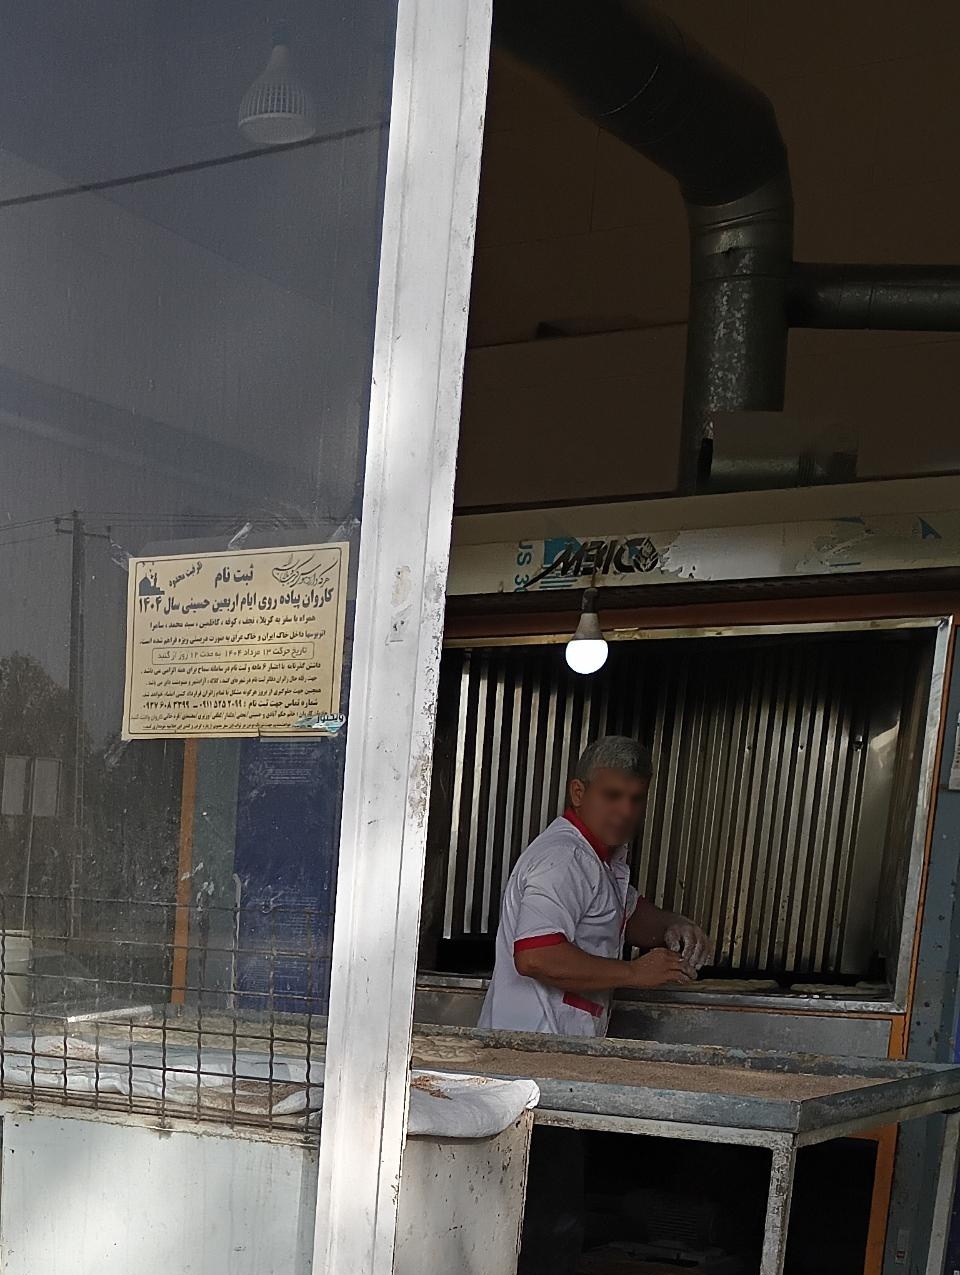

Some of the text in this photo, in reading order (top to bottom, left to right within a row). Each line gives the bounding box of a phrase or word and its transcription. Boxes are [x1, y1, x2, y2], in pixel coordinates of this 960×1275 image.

[215, 567, 231, 588] نام
[233, 563, 254, 586] ثبت
[139, 587, 335, 615] کاروان پیاده روی ایام اربعین حسینی سال ۱۴۰۴
[293, 615, 298, 623] با
[299, 614, 316, 624] همراه
[231, 634, 243, 643] عراق
[262, 632, 275, 641] ایران
[276, 631, 289, 639] خاک
[289, 631, 304, 639] داخل
[272, 647, 290, 657] حرکت
[291, 647, 308, 658] تاریخ
[249, 700, 257, 709] نام
[258, 699, 268, 707] ثبت
[285, 698, 300, 708] تماس
[301, 698, 318, 708] شماره
